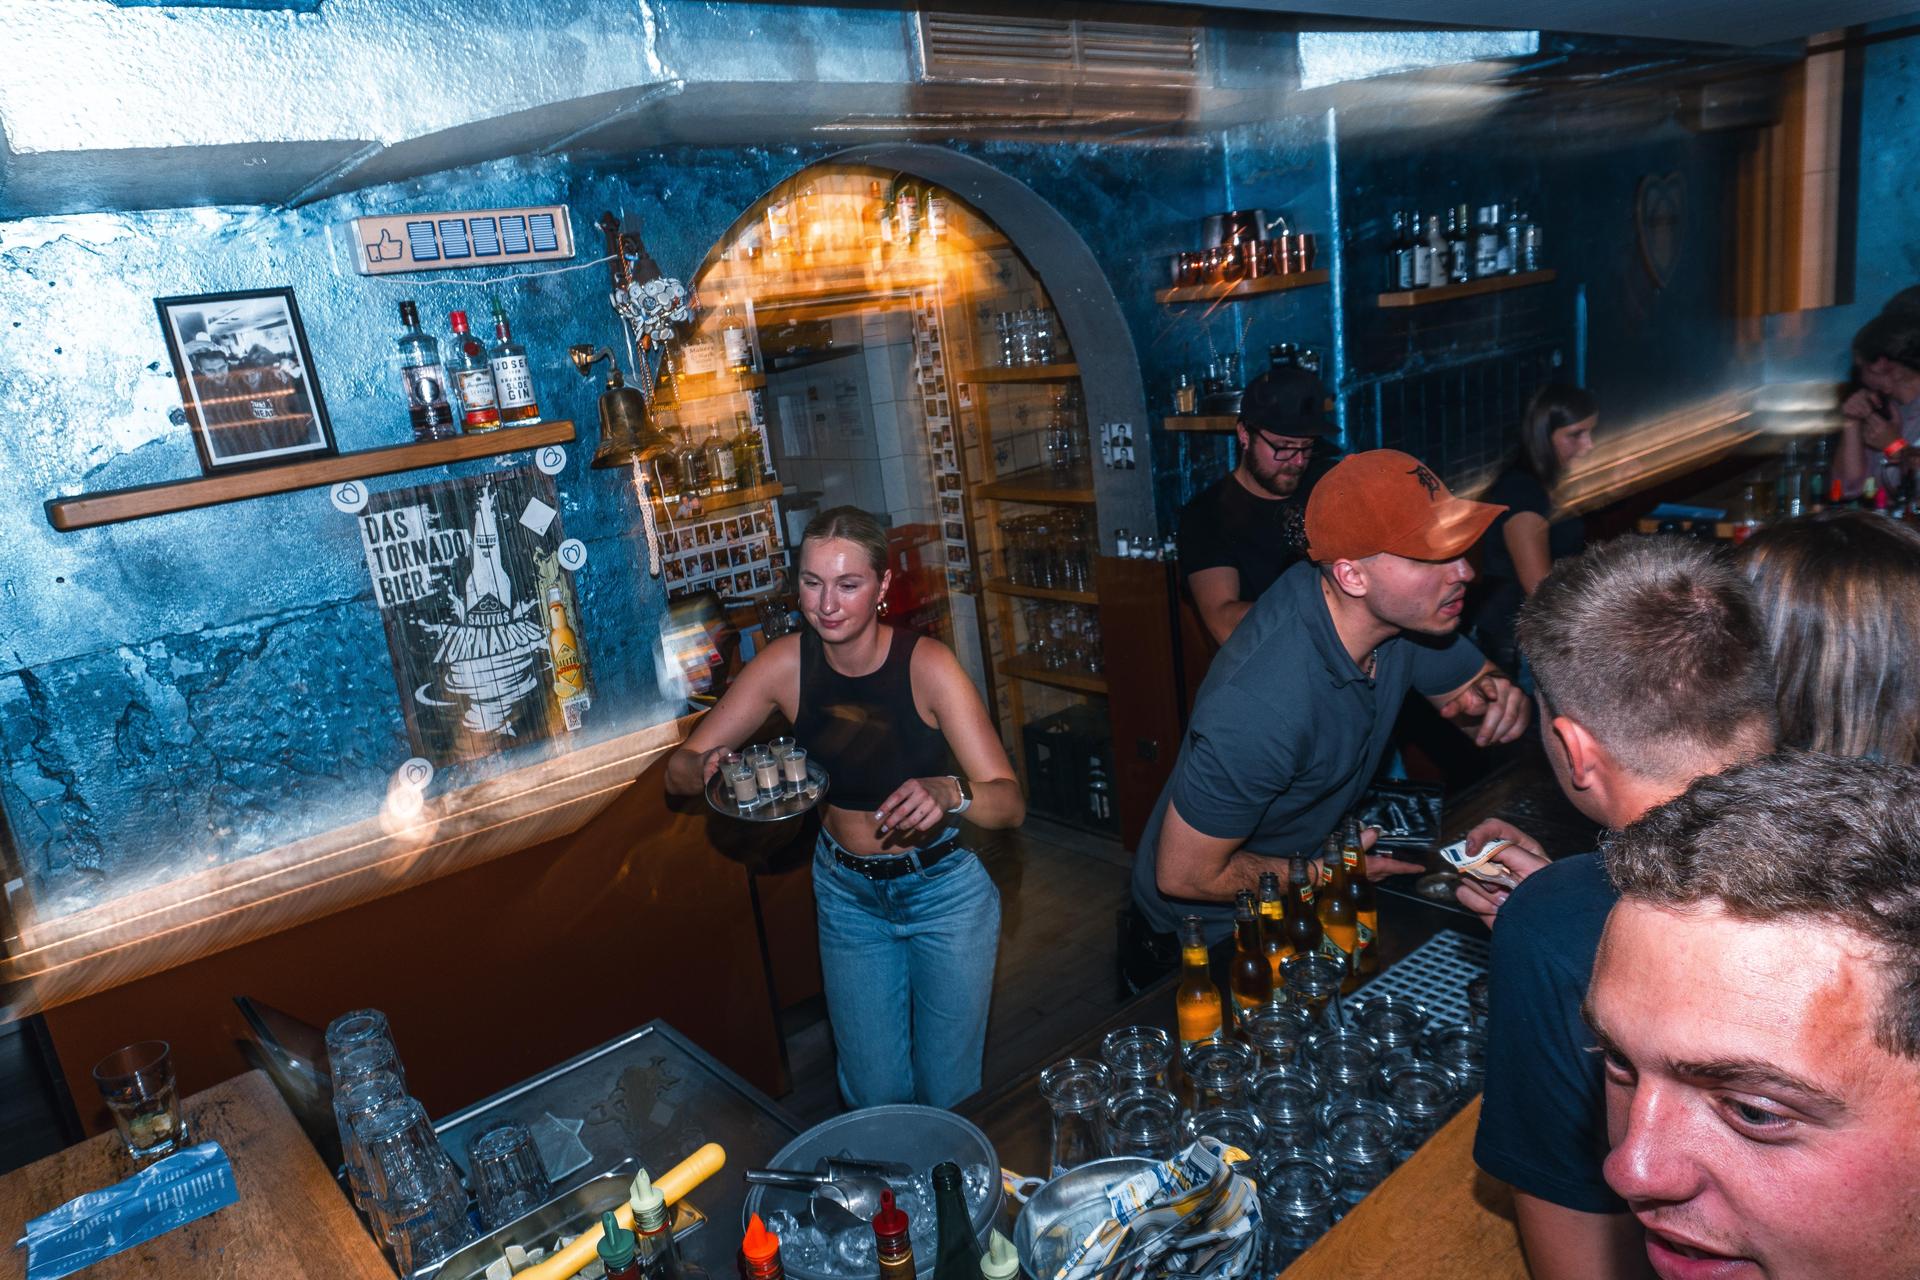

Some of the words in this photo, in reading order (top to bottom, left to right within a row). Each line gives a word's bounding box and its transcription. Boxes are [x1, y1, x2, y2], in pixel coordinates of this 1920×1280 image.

[506, 381, 528, 390] SLOE
[508, 388, 530, 400] GIN
[364, 511, 409, 544] DAS
[372, 531, 467, 573] TORNADO
[379, 570, 427, 604] BIER
[468, 611, 510, 626] SALITOS
